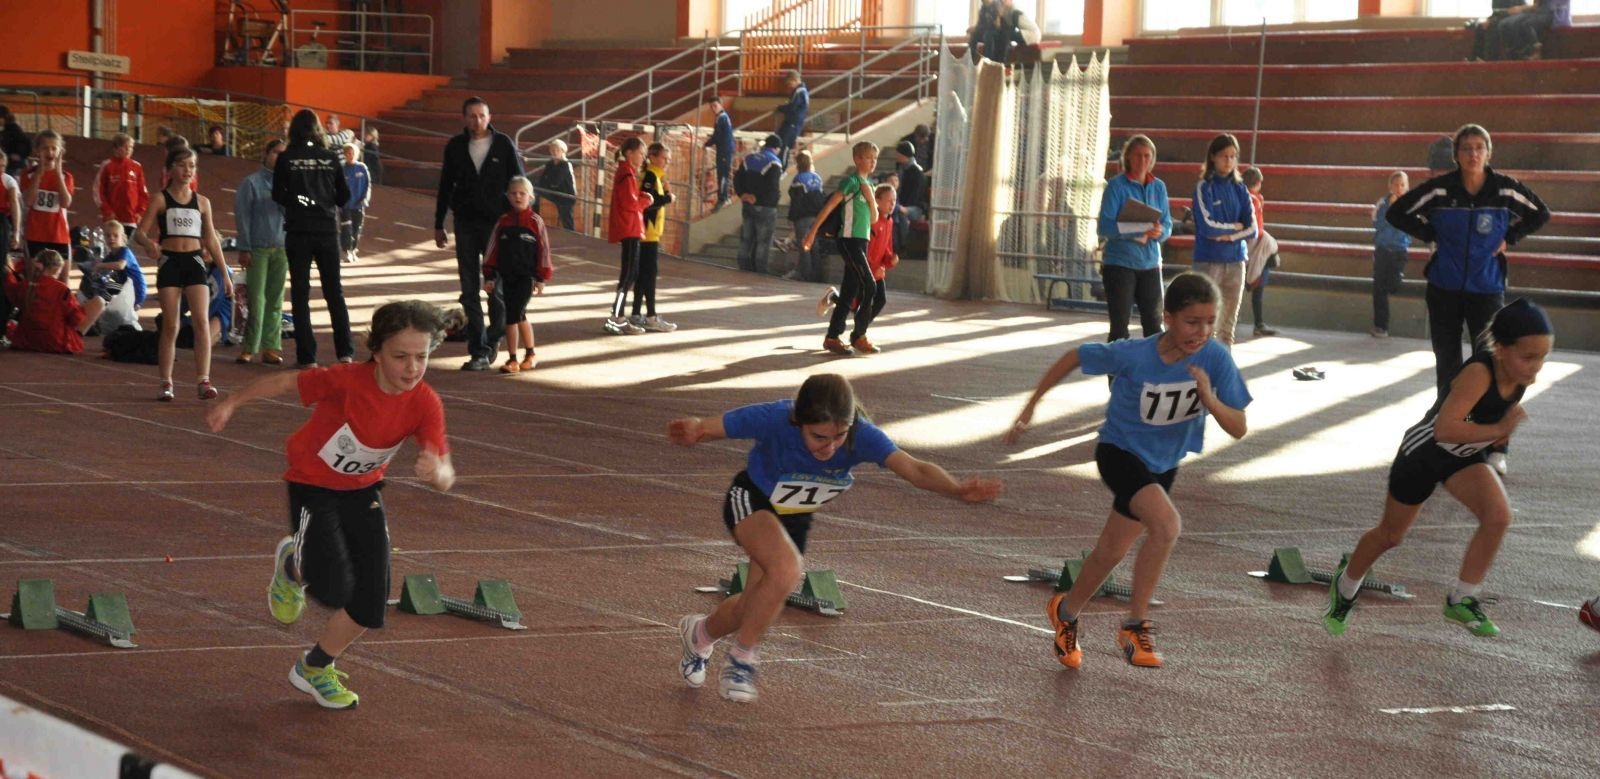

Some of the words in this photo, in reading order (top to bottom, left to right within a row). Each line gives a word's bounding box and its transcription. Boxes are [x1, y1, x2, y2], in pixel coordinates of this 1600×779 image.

[37, 191, 55, 208] 88
[173, 217, 193, 227] 1989
[1146, 387, 1200, 420] 772
